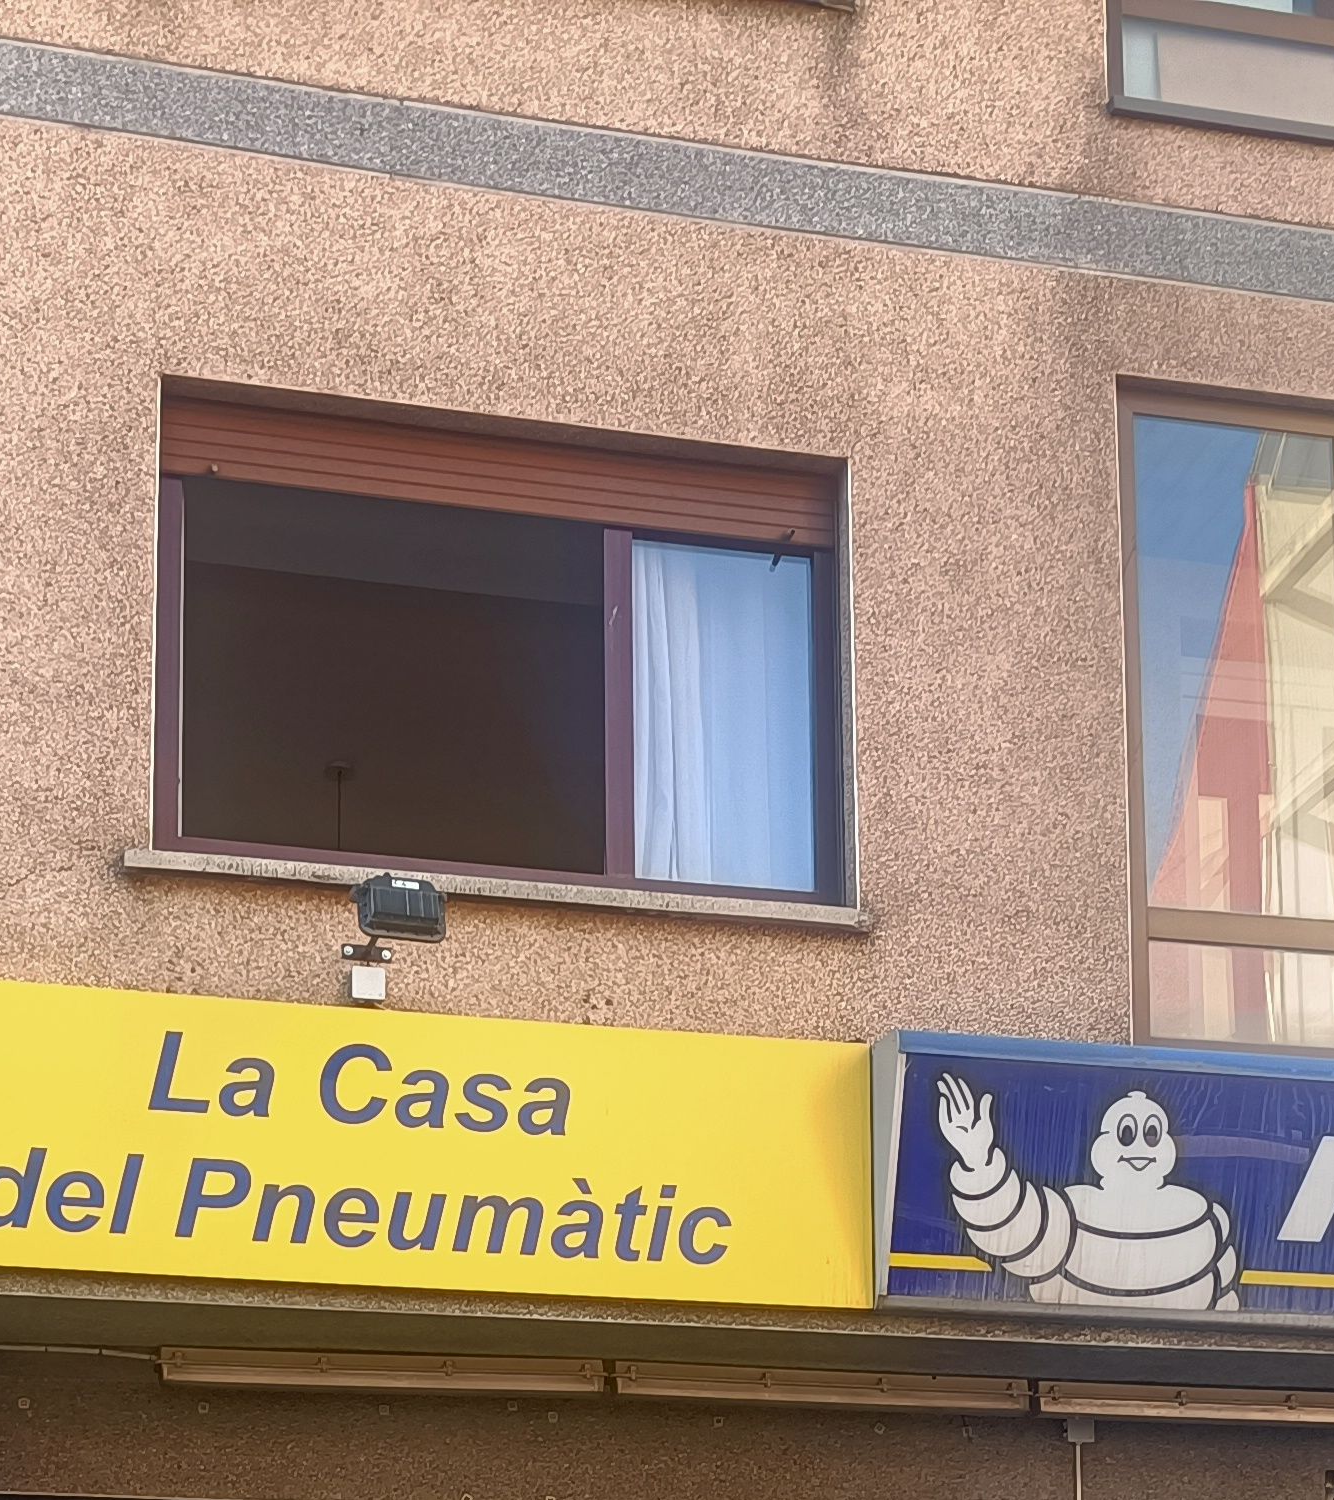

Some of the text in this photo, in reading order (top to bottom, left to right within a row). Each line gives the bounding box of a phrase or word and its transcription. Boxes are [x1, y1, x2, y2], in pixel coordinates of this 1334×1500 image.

[148, 1030, 573, 1137] La Casa
[174, 1157, 733, 1266] Pneumàtic
